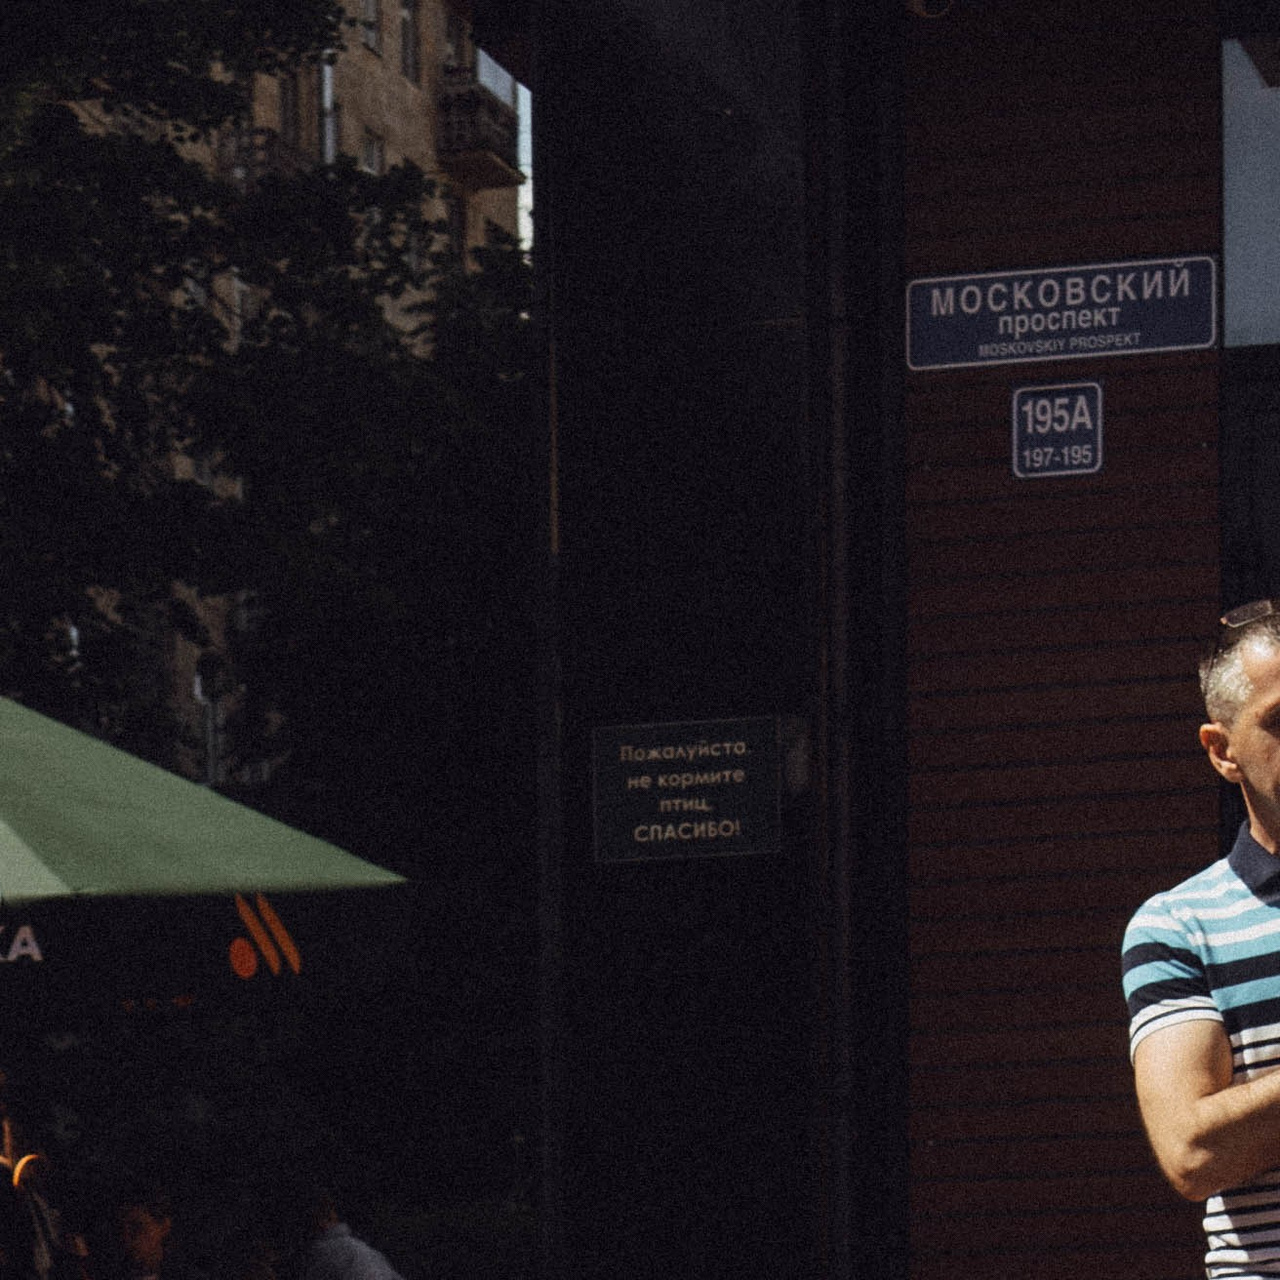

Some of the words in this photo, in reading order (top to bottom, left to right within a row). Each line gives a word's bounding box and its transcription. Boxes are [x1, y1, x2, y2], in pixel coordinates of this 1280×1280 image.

[931, 261, 1191, 317] МОСКОВСКИЙ
[998, 306, 1122, 339] проспект
[978, 338, 1065, 357] MOSKOVSKIY
[1069, 333, 1141, 349] PROSPEKT
[1021, 396, 1093, 433] 195А
[1022, 444, 1093, 469] 197-195
[627, 775, 651, 789] не
[657, 769, 745, 788] кормите
[634, 820, 741, 842] СПАСИБО!
